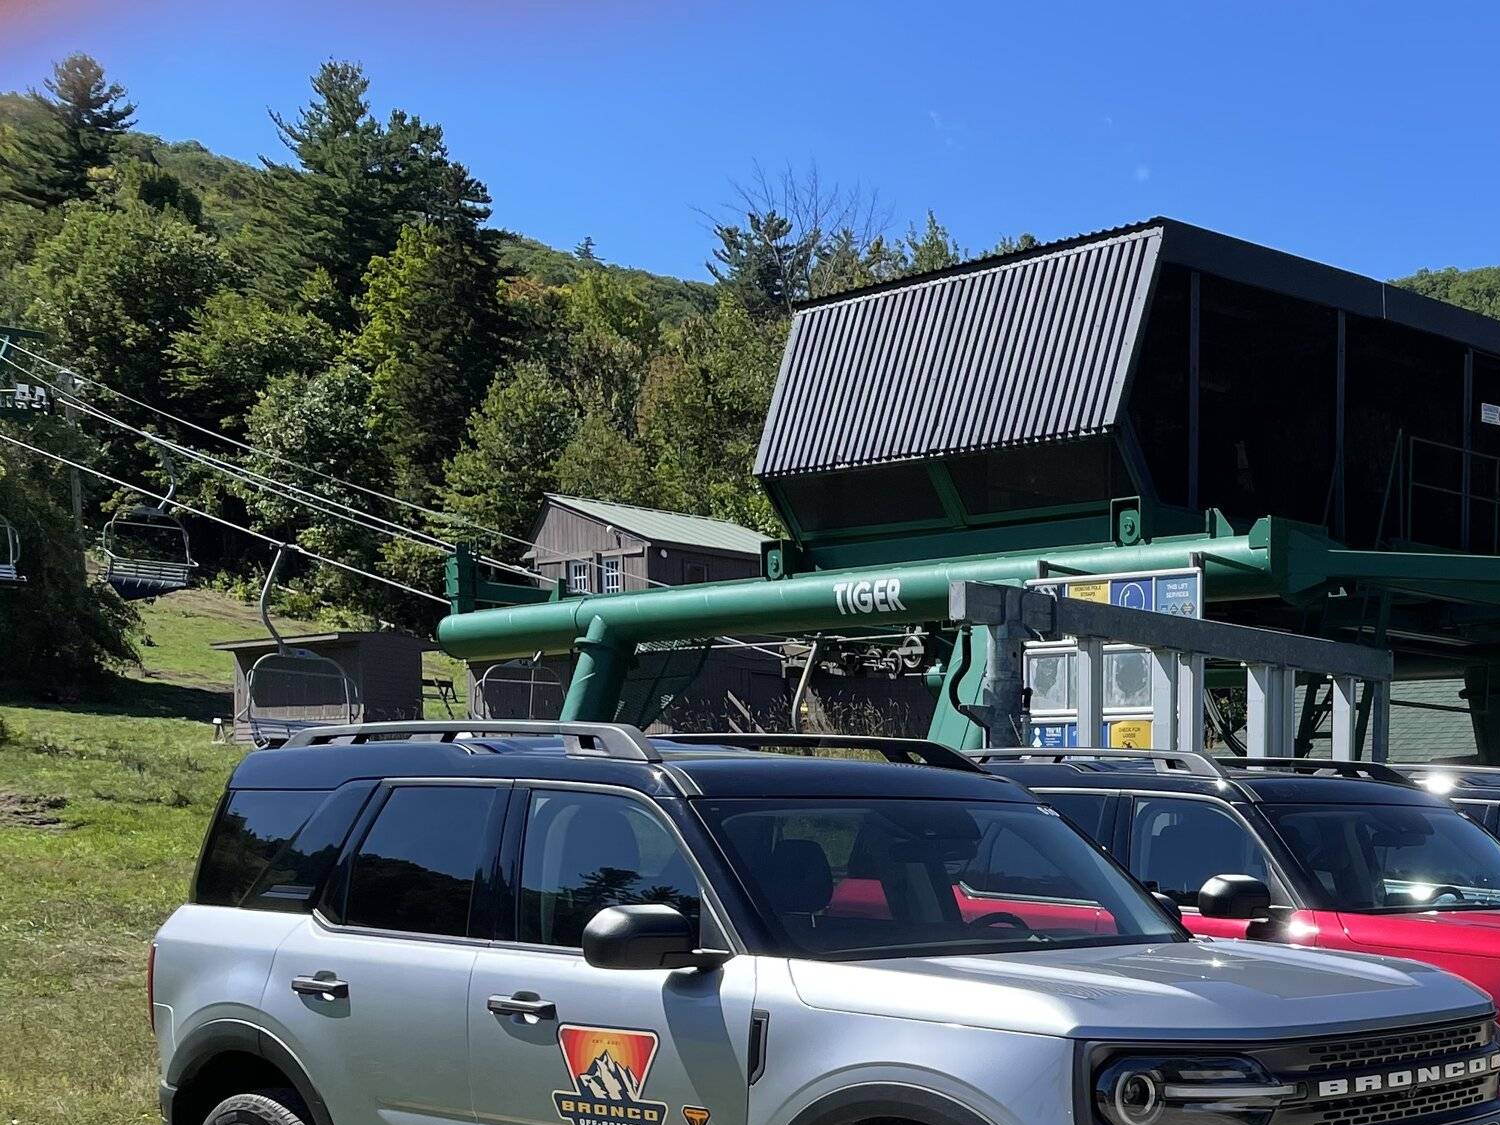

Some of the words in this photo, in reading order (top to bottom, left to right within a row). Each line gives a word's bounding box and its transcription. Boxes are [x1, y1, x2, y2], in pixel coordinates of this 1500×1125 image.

[833, 579, 906, 615] TIGER
[1166, 590, 1189, 598] SERVICES
[1319, 1056, 1488, 1097] BRONCO
[561, 1100, 659, 1122] BRONCO
